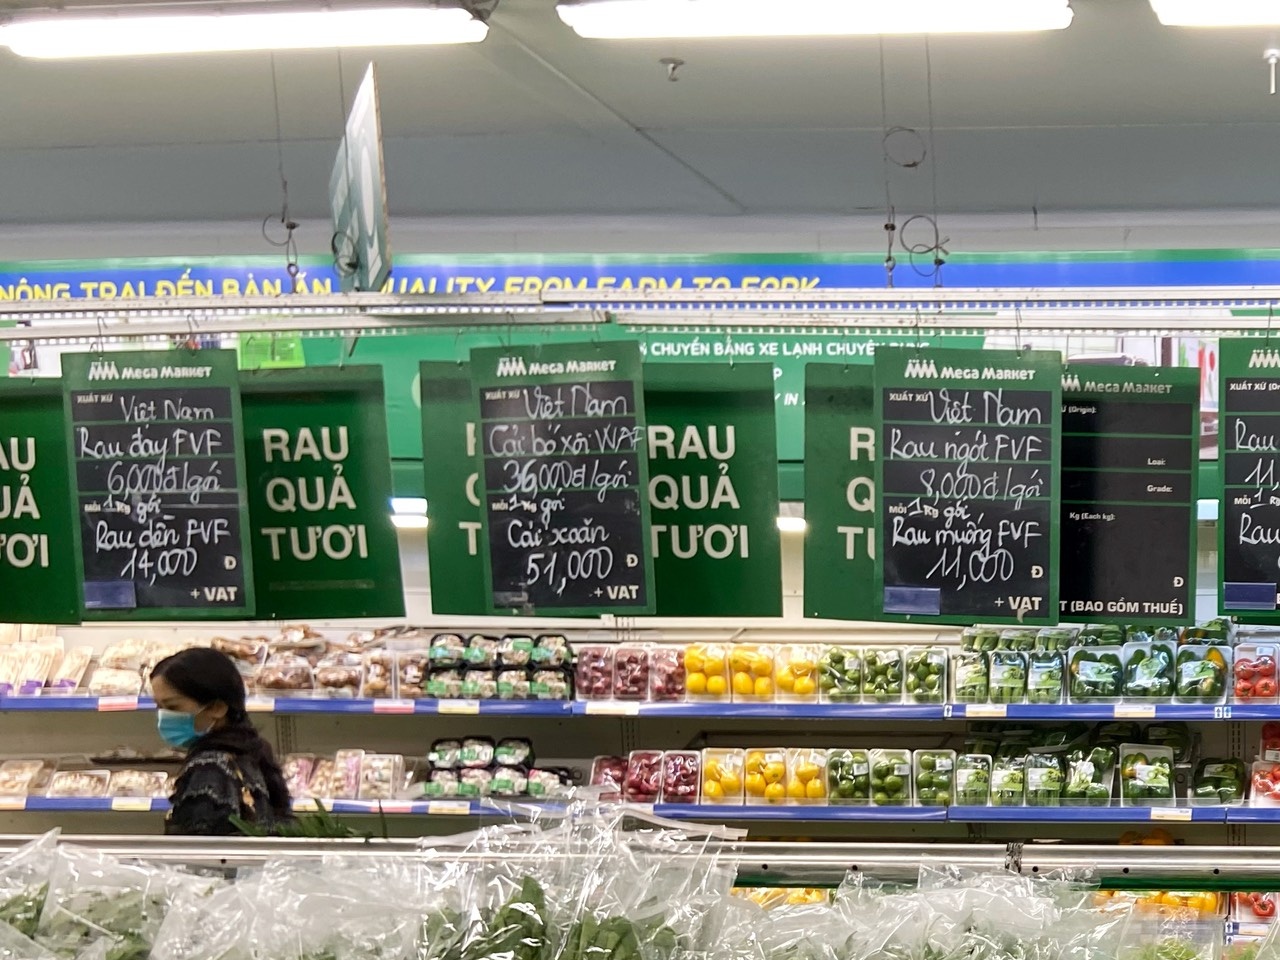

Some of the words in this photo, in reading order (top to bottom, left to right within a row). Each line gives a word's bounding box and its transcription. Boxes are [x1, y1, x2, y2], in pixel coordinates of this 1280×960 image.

[382, 277, 495, 294] UALITY
[759, 342, 778, 356] XE
[164, 398, 214, 420] Nam
[571, 383, 628, 417] Nam
[983, 388, 1041, 427] Nam
[79, 426, 124, 458] Rau
[173, 429, 222, 456] FVF
[262, 426, 349, 462] RAU
[647, 425, 735, 460] RAU
[891, 428, 938, 460] Rau
[996, 435, 1042, 463] FVF
[1235, 418, 1277, 452] Rau
[266, 463, 357, 512] QUẢ
[649, 462, 740, 510] QUẢ
[96, 520, 135, 552] Rau
[187, 518, 231, 547] FVF
[261, 524, 368, 560] TƯƠI
[651, 524, 748, 559] TƯƠI
[892, 516, 931, 547] Rau
[998, 520, 1042, 548] FVF
[527, 546, 613, 595] 51,000
[926, 546, 1014, 590] 11,000
[204, 587, 238, 601] VAT
[607, 585, 639, 600] VAT
[1009, 597, 1042, 610] VAT
